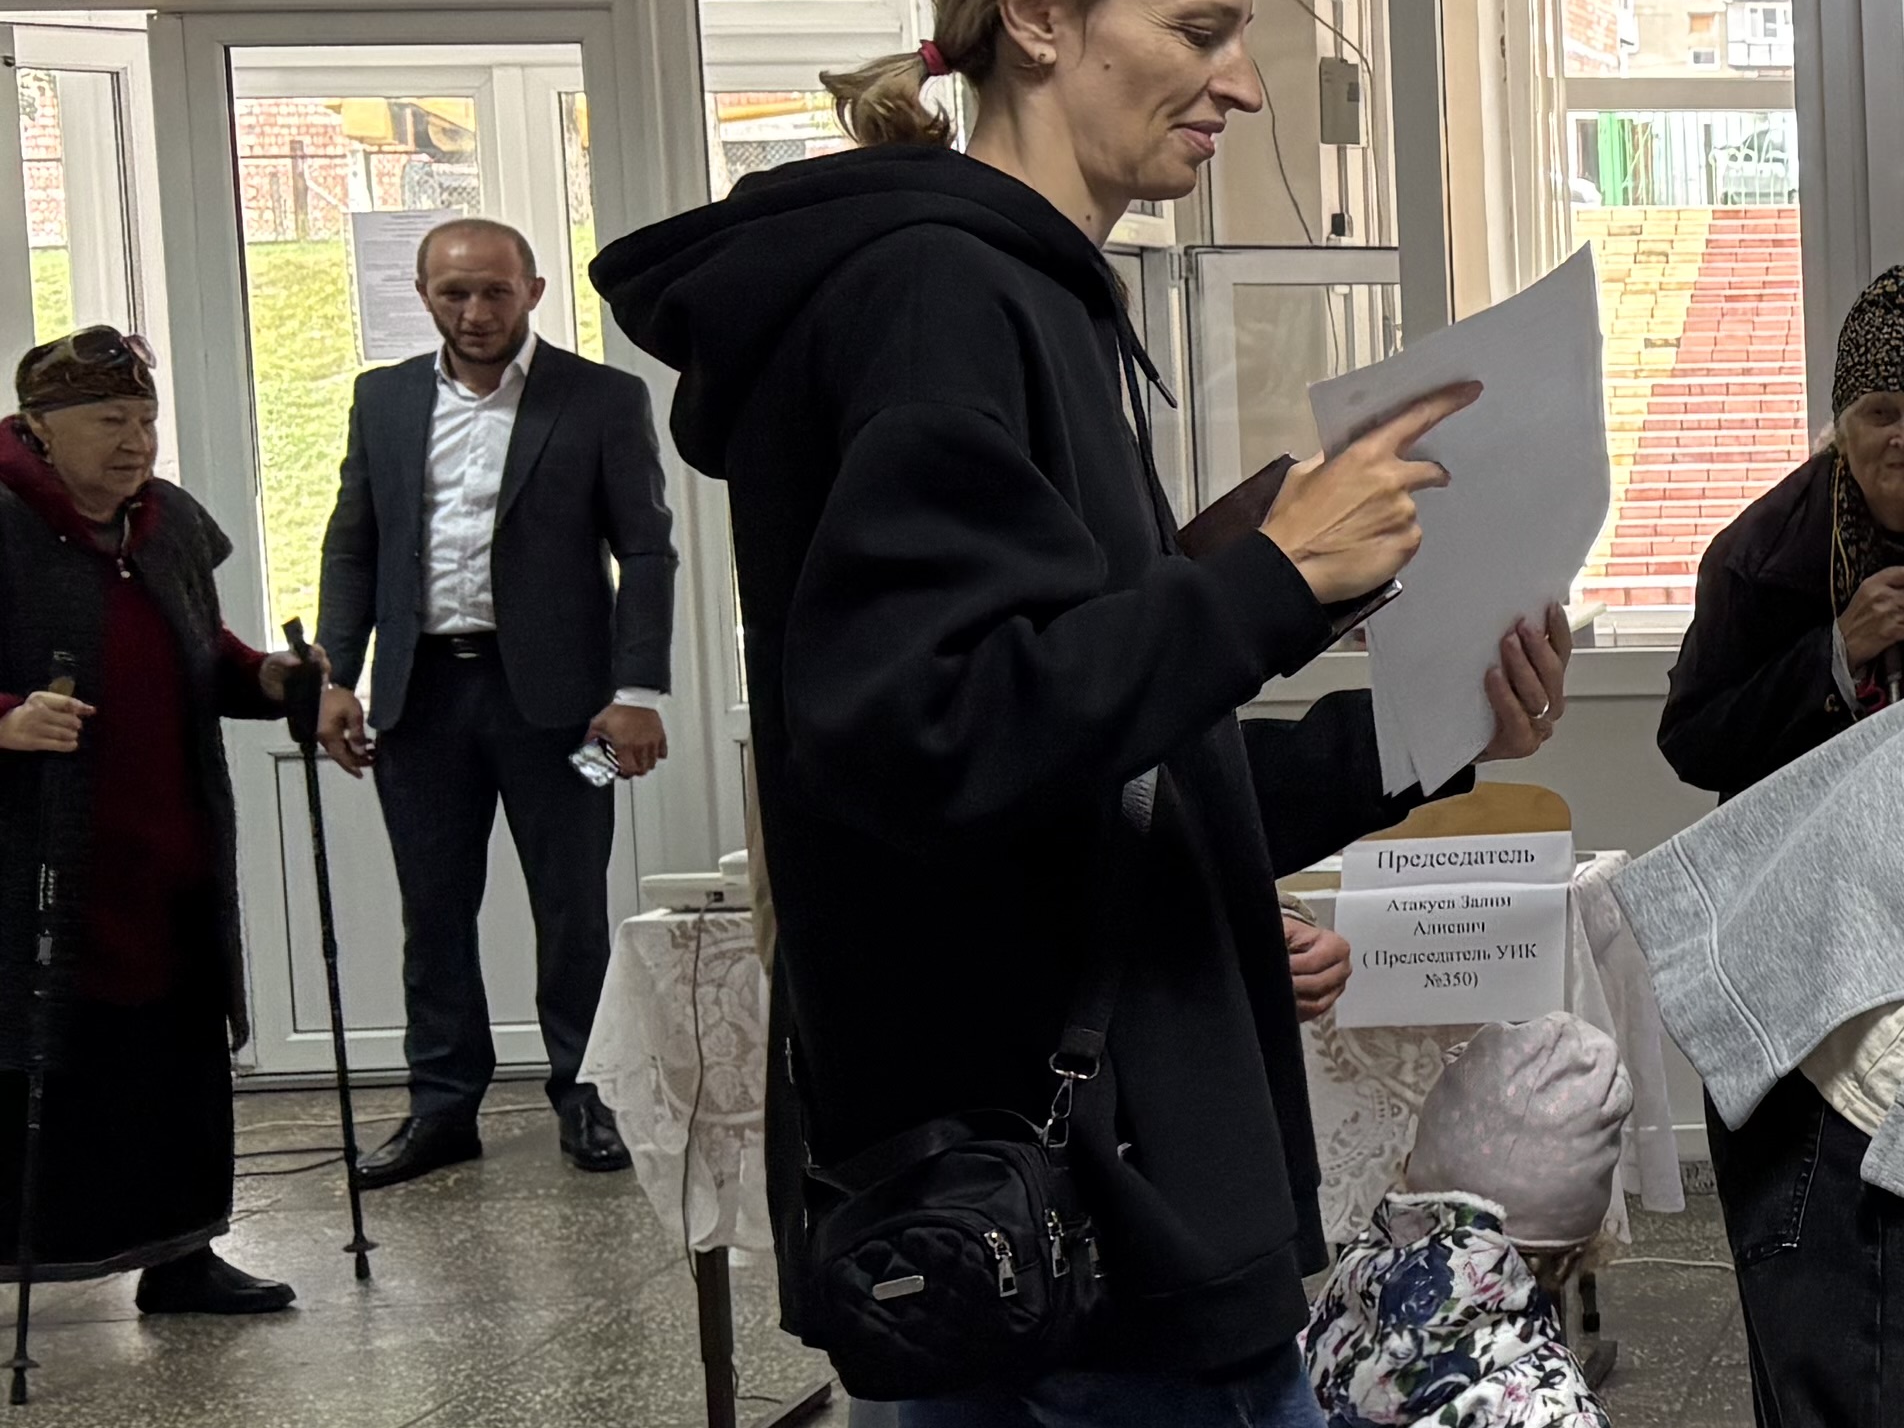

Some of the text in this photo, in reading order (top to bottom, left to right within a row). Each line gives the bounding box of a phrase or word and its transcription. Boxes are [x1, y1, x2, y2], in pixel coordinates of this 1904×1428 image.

[1377, 848, 1535, 874] Председатель
[1387, 897, 1456, 914] Атакуев
[1413, 919, 1486, 936] Алиевич
[1496, 942, 1539, 961] УИК
[1423, 971, 1479, 989] №350)
